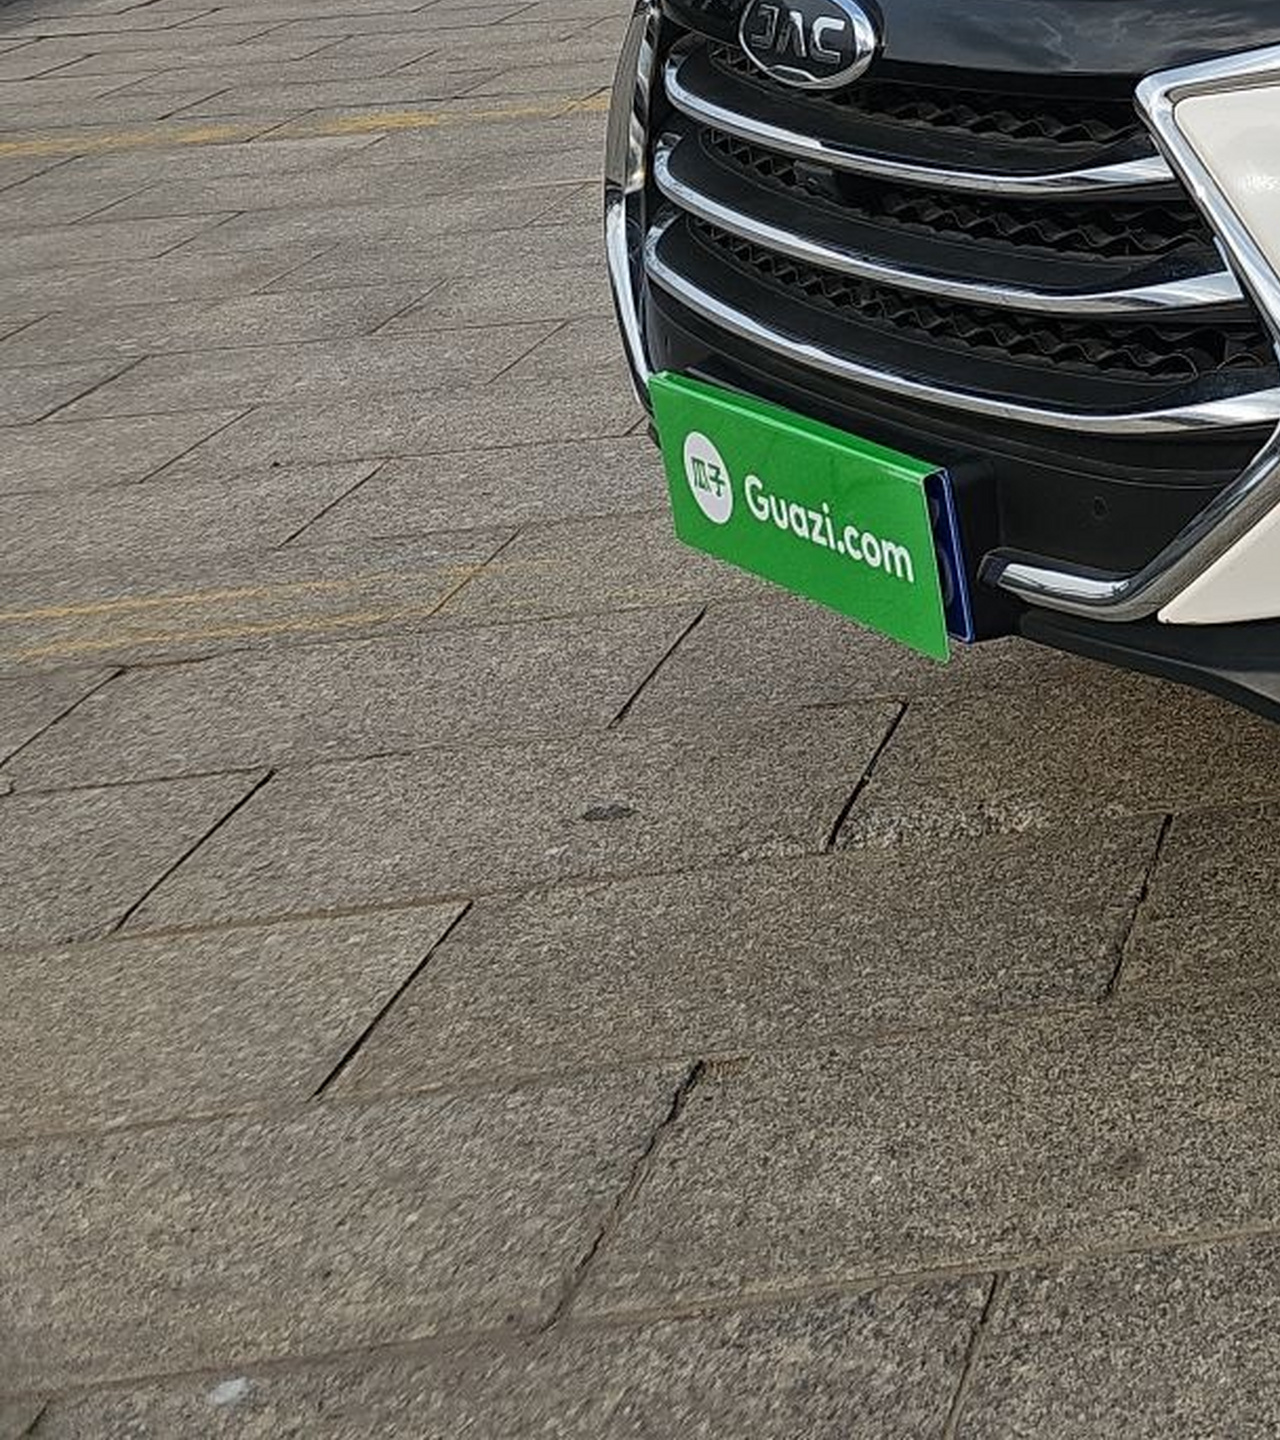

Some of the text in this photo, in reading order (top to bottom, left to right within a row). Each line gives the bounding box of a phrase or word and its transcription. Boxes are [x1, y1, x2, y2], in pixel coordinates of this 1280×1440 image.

[750, 3, 846, 63] JAC
[690, 455, 727, 498] 瓜子
[744, 474, 915, 583] Guazi.com
